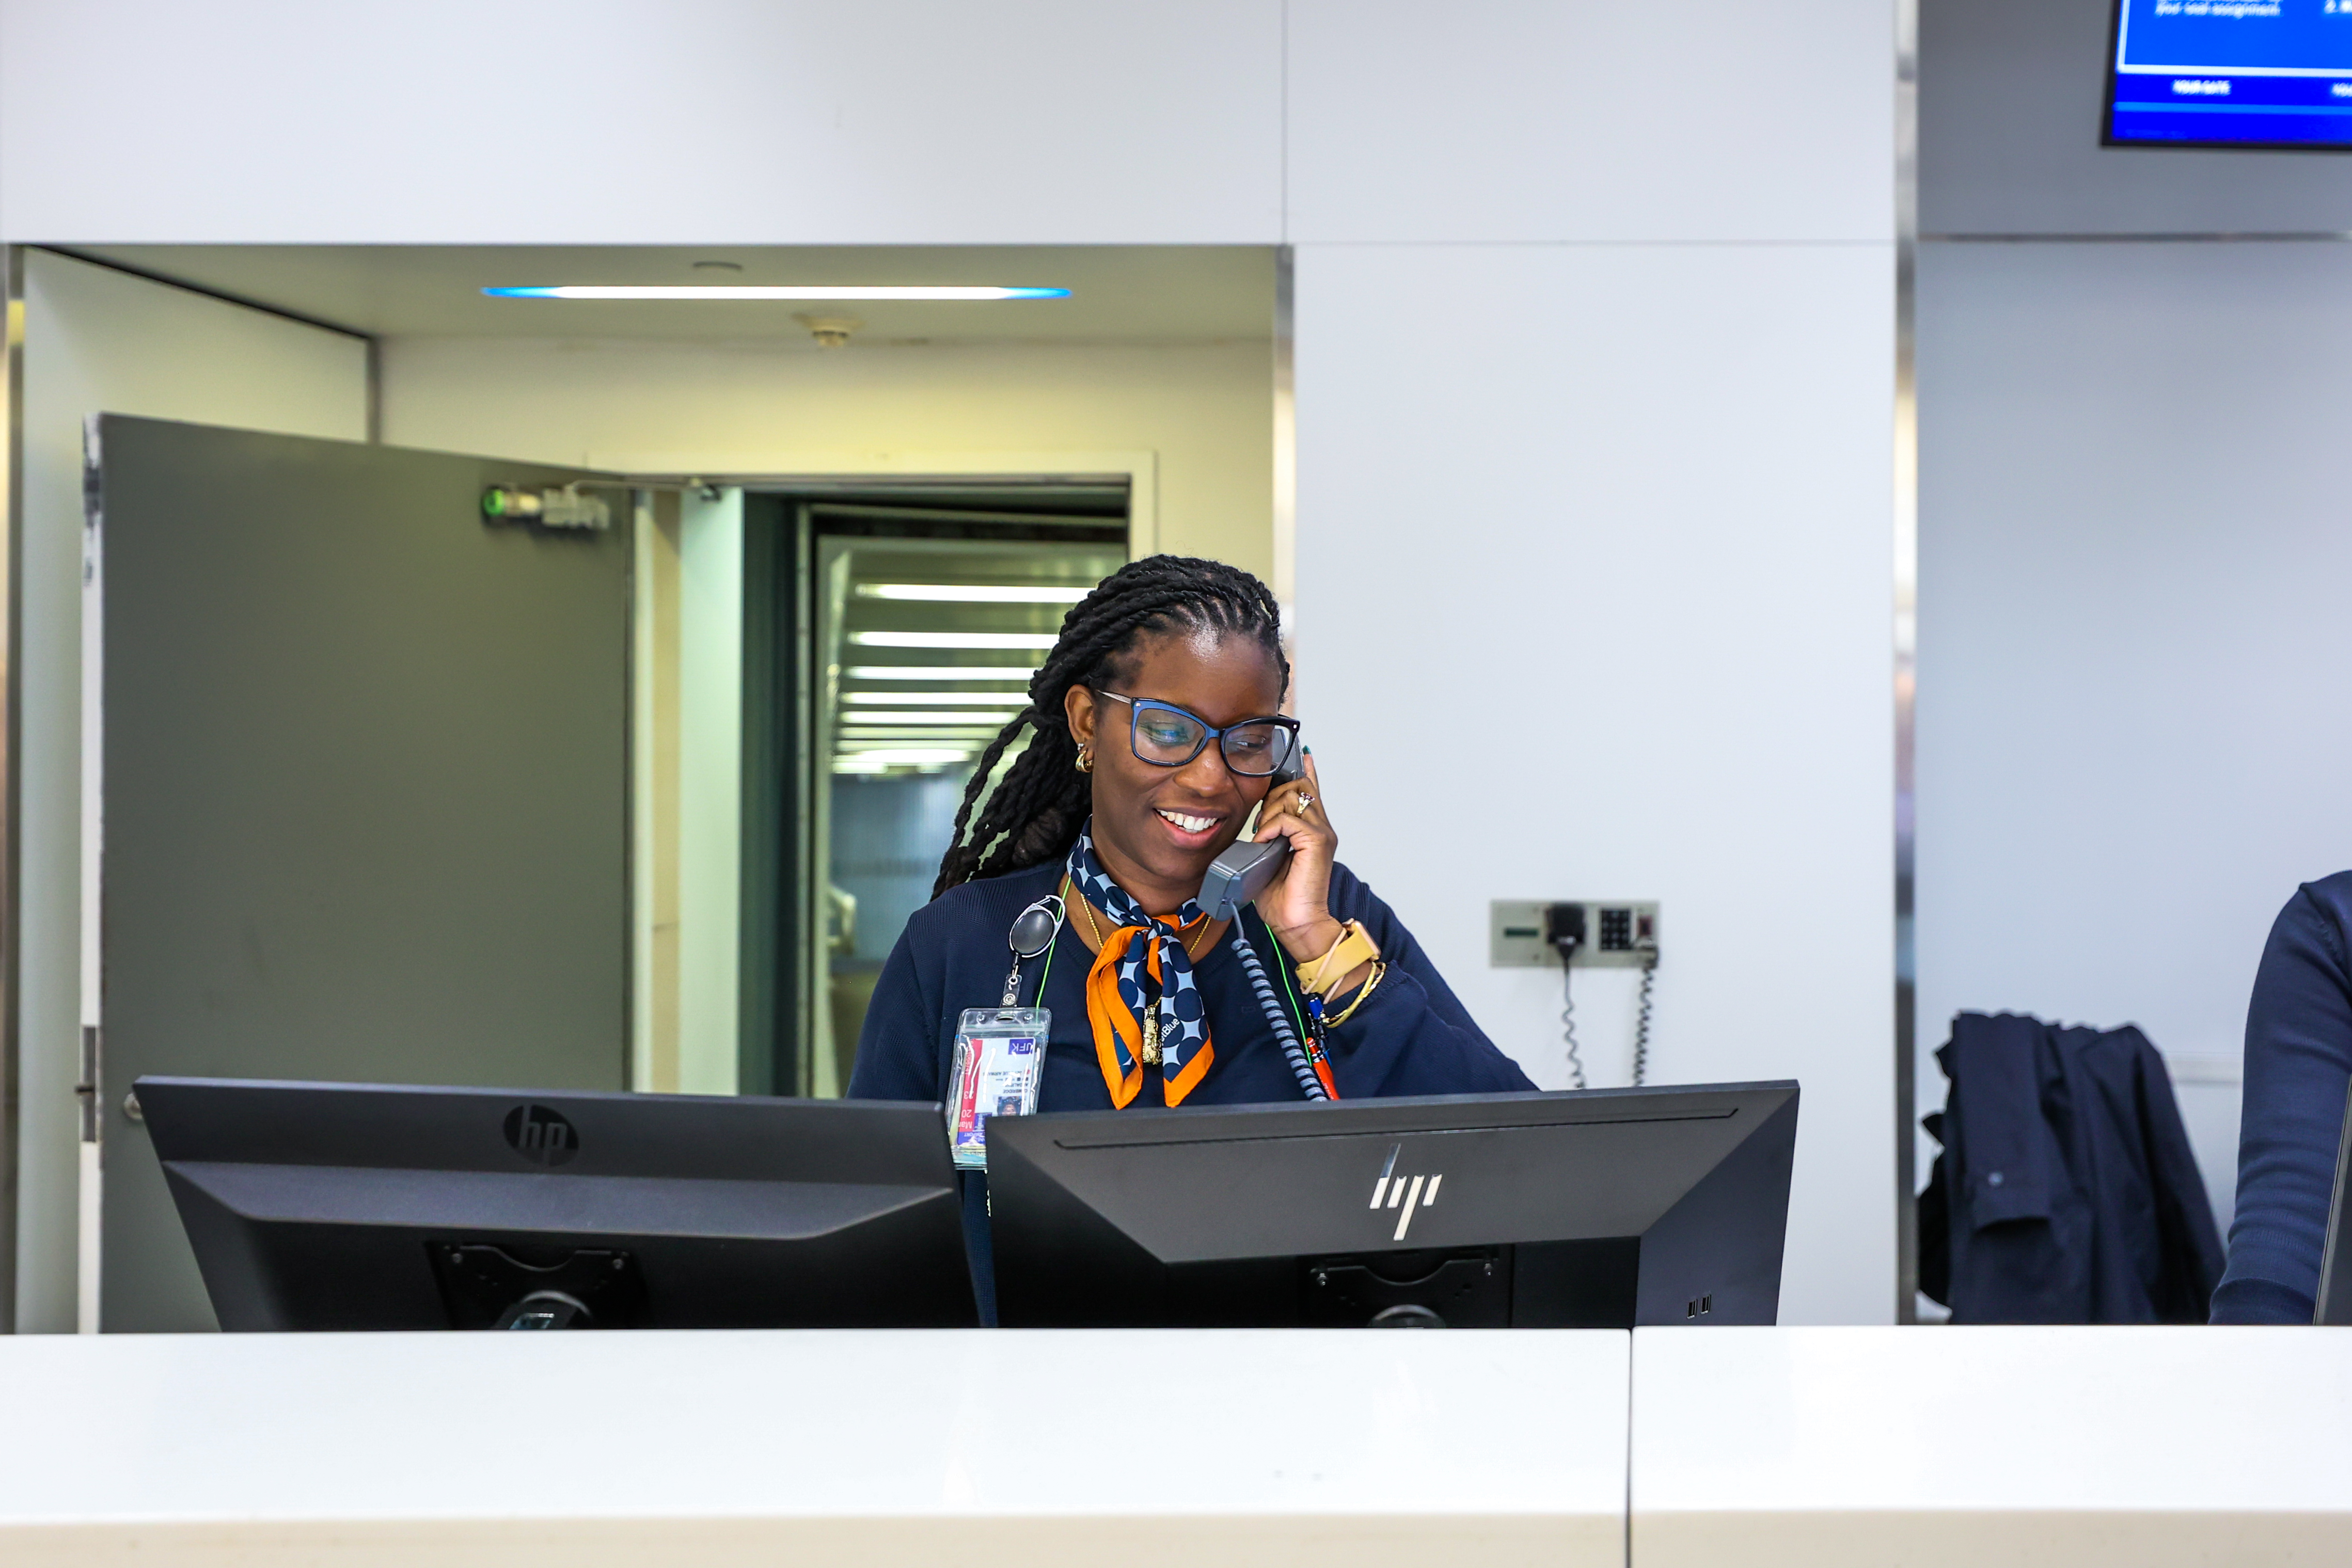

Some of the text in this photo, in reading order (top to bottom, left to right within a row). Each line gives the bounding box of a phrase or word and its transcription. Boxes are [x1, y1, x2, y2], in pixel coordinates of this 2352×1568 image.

[1161, 1018, 1180, 1044] etBlue
[1012, 1043, 1033, 1052] JFK
[962, 1109, 972, 1118] 20
[958, 1121, 973, 1129] Mar
[516, 1104, 569, 1166] hp
